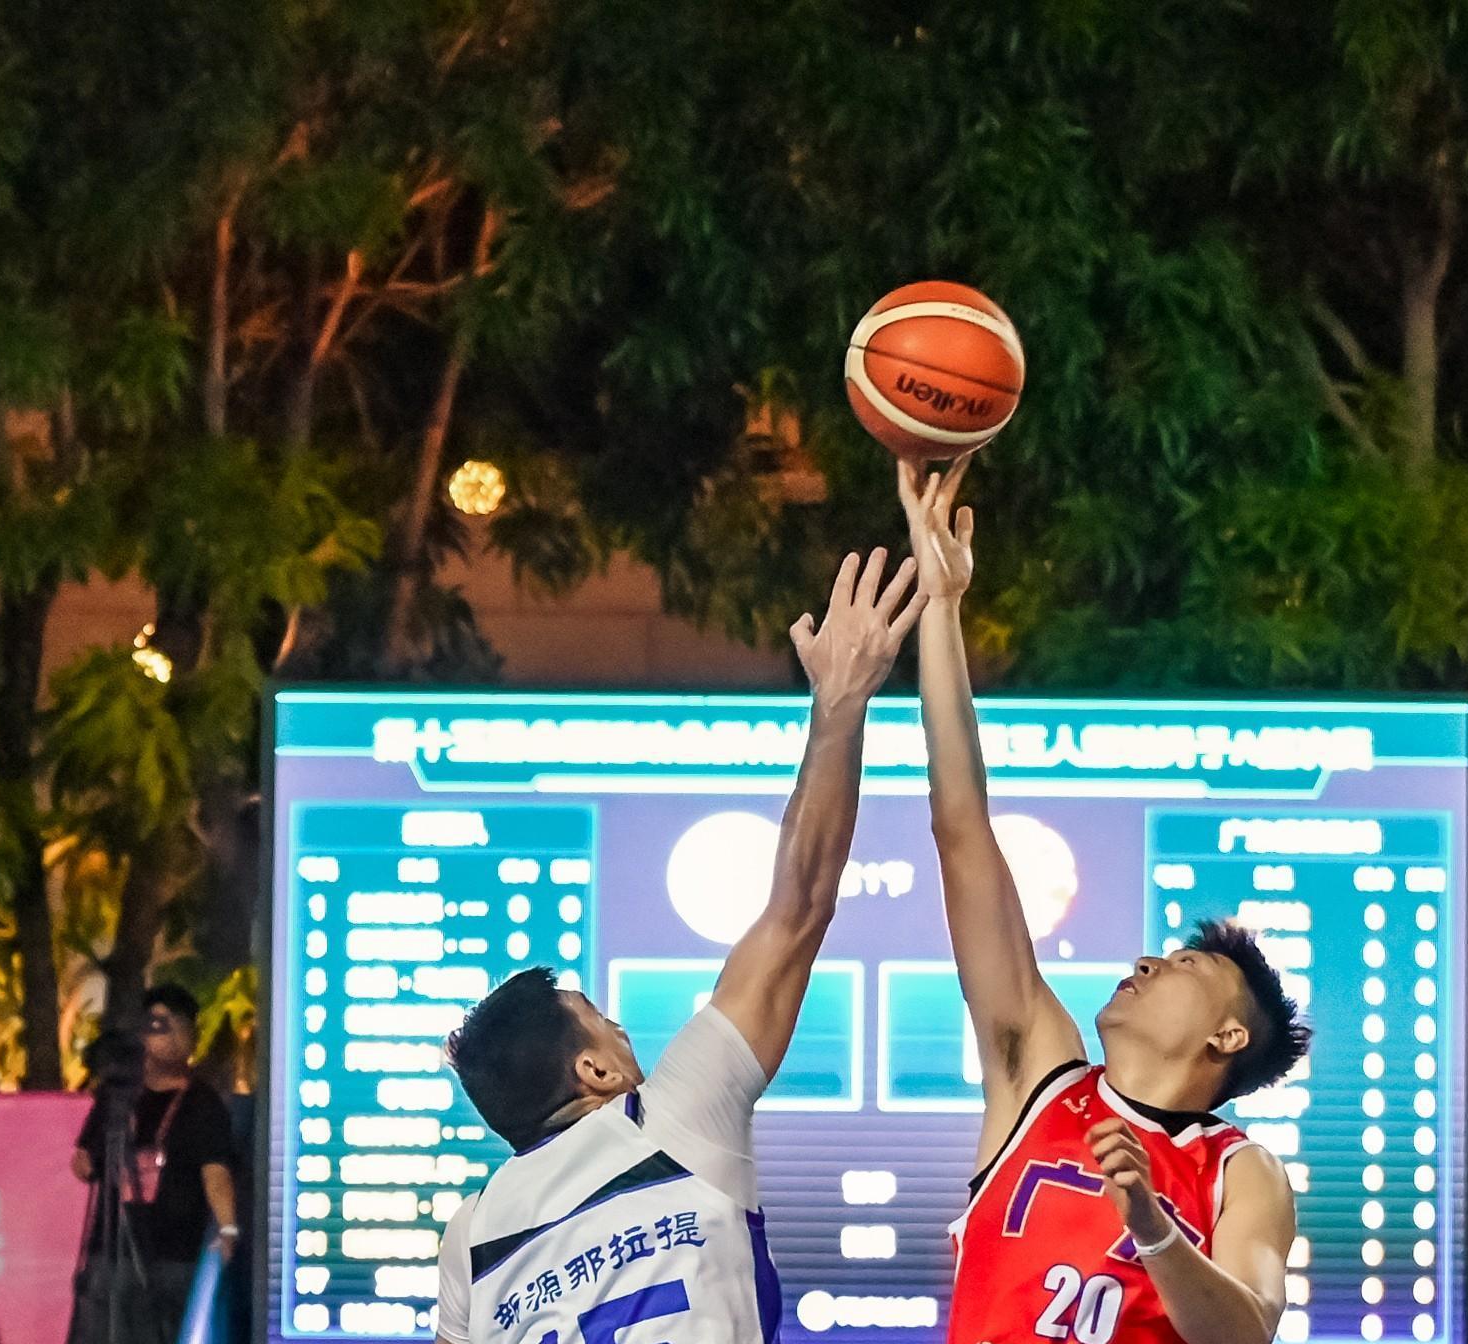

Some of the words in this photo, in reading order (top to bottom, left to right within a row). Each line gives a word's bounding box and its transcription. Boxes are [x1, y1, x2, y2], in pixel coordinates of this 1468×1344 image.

[895, 373, 993, 416] molten
[493, 1210, 707, 1330] 新源那拉提
